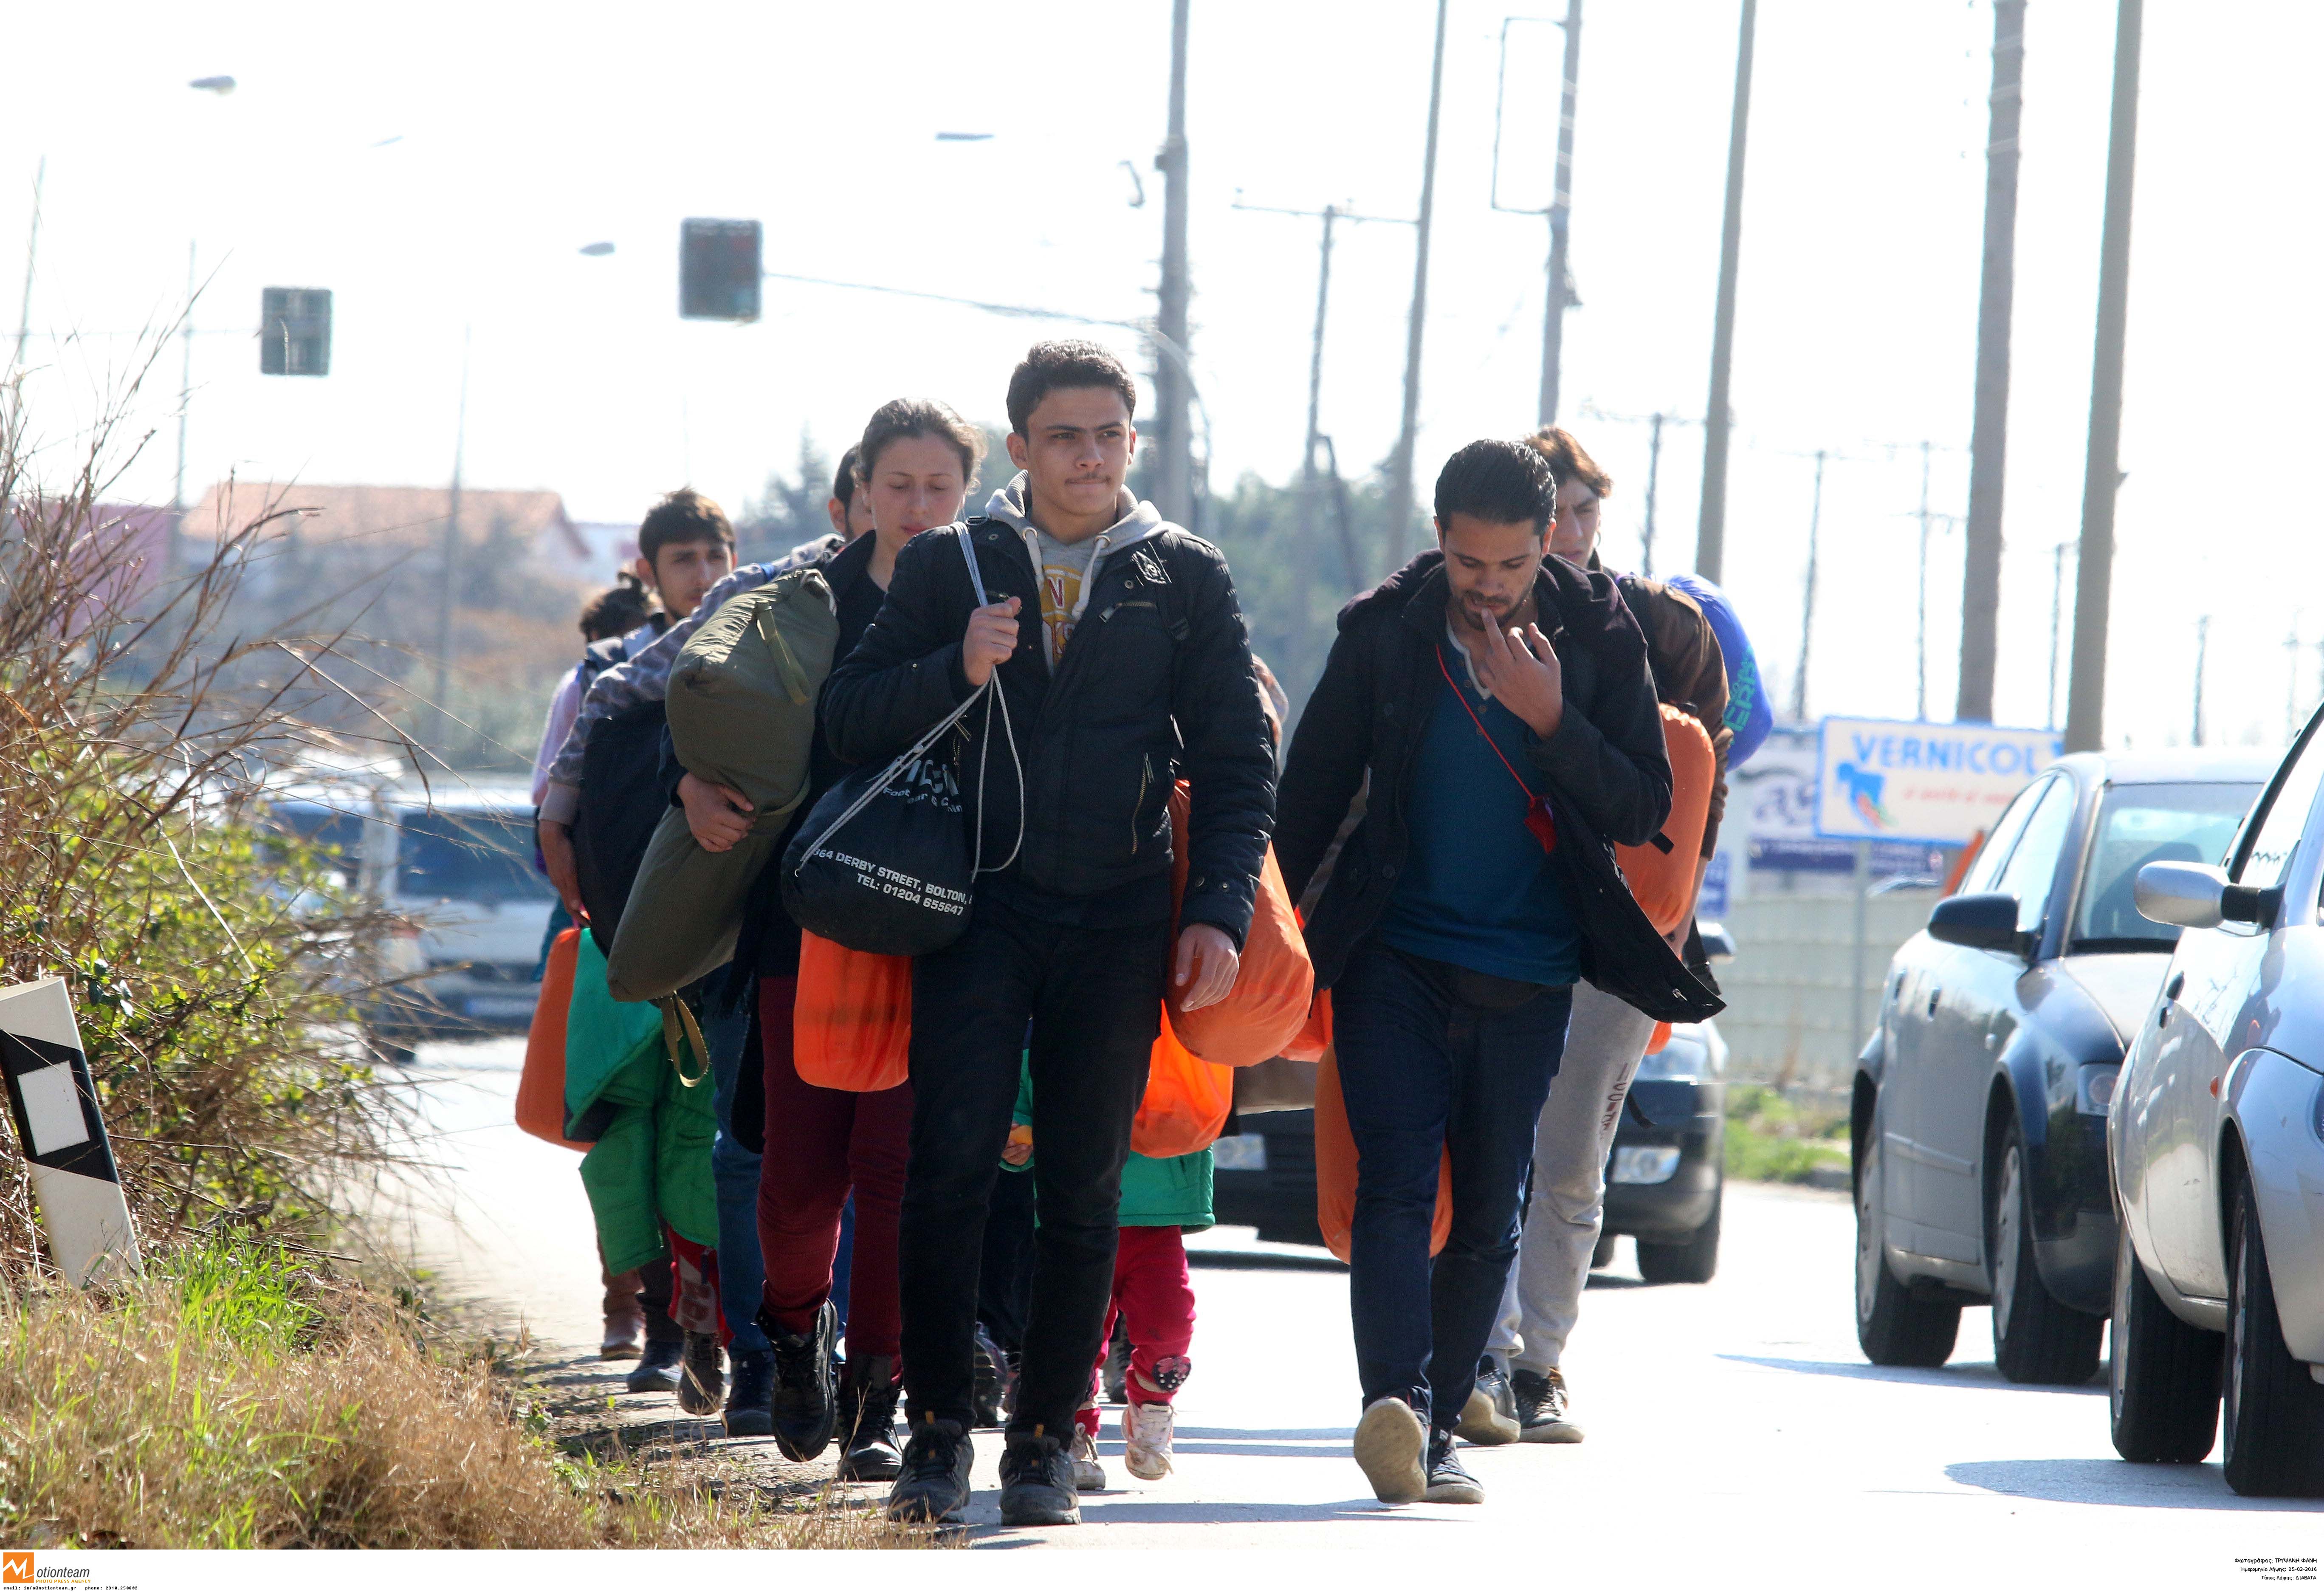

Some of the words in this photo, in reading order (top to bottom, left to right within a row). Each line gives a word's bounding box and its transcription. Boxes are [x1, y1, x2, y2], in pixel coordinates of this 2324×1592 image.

[1853, 731, 2037, 776] VERNICOL
[835, 852, 876, 872] DERBY
[877, 867, 921, 892] STREET,
[925, 883, 967, 904] BOLTON,
[857, 873, 880, 890] TEL:
[883, 884, 921, 904] 01204
[922, 897, 964, 915] 655647
